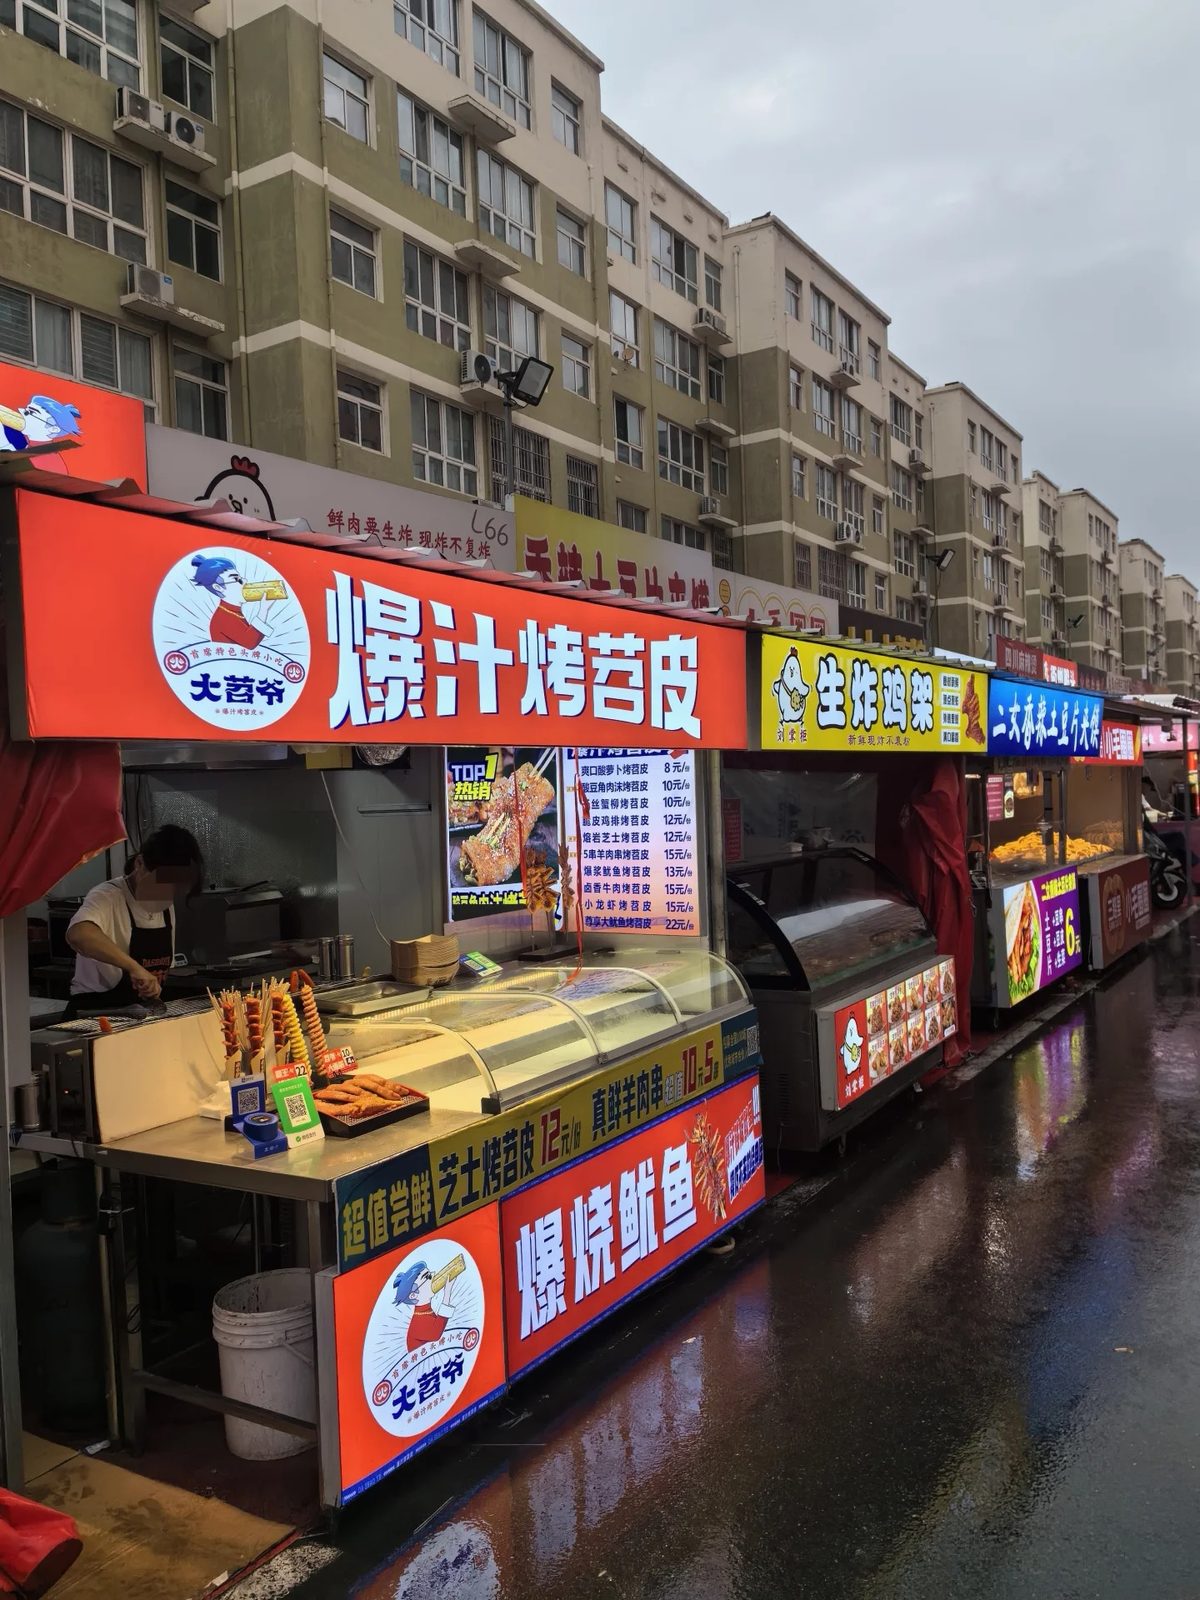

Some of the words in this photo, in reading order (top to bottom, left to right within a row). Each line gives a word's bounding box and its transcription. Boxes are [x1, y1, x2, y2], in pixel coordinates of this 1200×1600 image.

[327, 508, 413, 547] 鲜肉要生炸
[419, 530, 491, 559] 现炸不复炸
[326, 570, 702, 740] 爆汁烤苕皮
[190, 673, 285, 706] 大苕爷
[816, 653, 934, 734] 生炸鸡架
[454, 781, 492, 801] 热销
[581, 797, 649, 810] 丝蟹柳烤苕皮
[583, 882, 651, 895] 卤香牛肉烤苕皮
[584, 899, 652, 912] 小龙虾烤苕皮
[342, 1169, 430, 1261] 超值尝鲜
[438, 1120, 535, 1220] 芝士烤苕皮
[516, 1141, 698, 1341] 爆烧鱿鱼
[392, 1352, 464, 1420] 大苕爷
